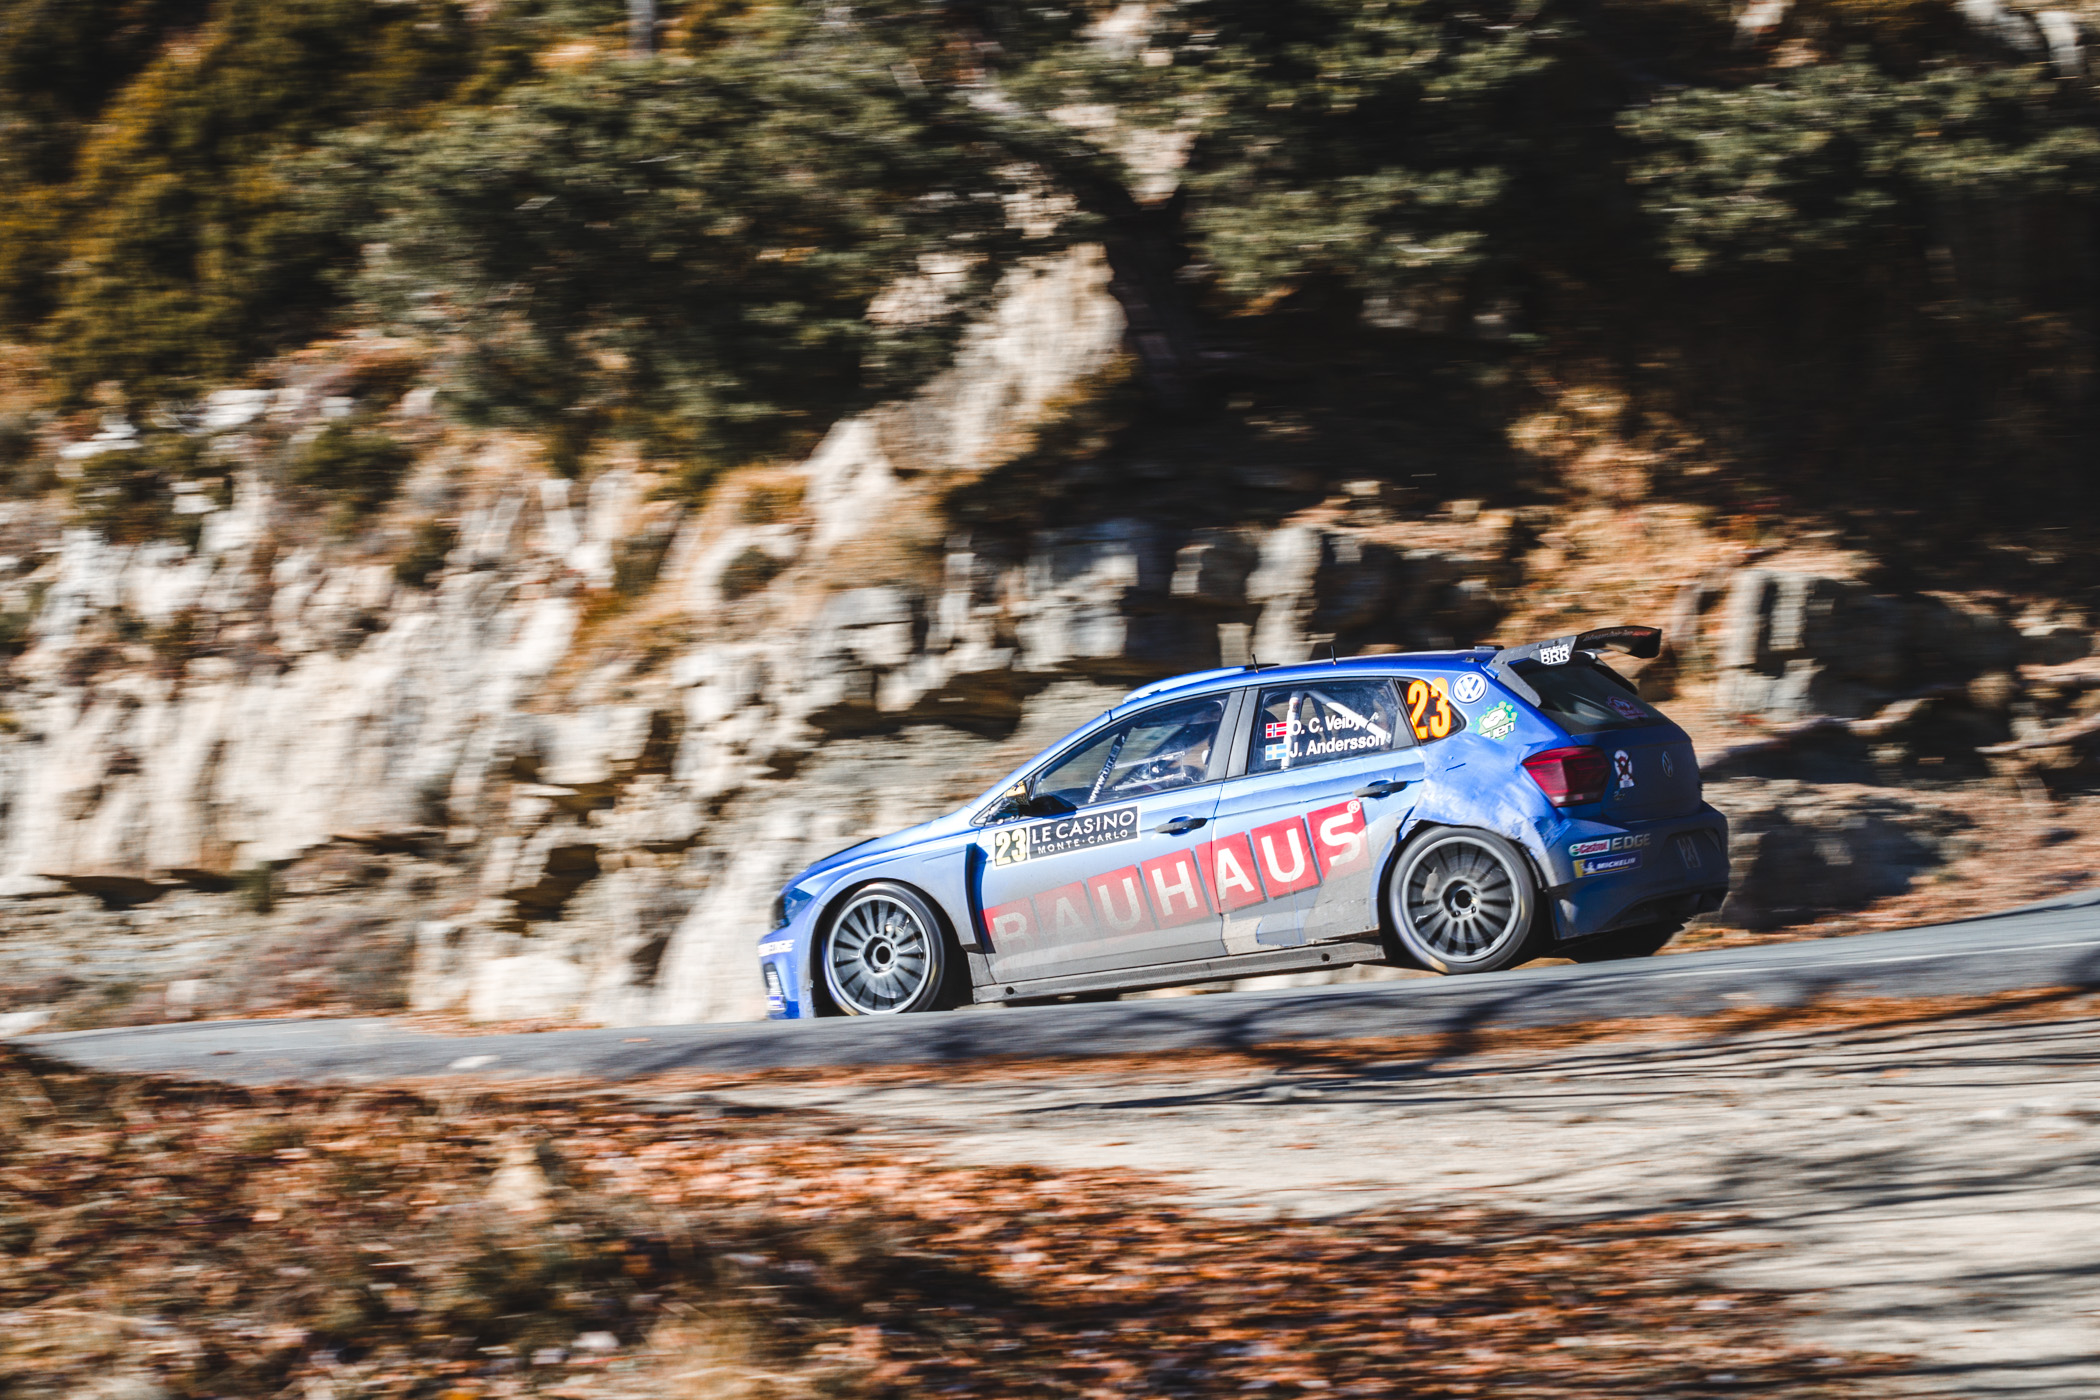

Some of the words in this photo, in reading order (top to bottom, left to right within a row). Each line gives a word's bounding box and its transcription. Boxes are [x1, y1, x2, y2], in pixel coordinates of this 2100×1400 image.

[1540, 647, 1570, 666] BRR
[1407, 677, 1452, 740] 23
[1289, 741, 1302, 758] J.
[1306, 733, 1386, 757] Andersson
[1031, 826, 1052, 845] LE
[1055, 810, 1135, 839] CASINO
[995, 828, 1027, 866] 23
[1577, 840, 1609, 854] Castrol
[1611, 833, 1651, 851] EDGE
[1596, 856, 1637, 870] MICHELIN
